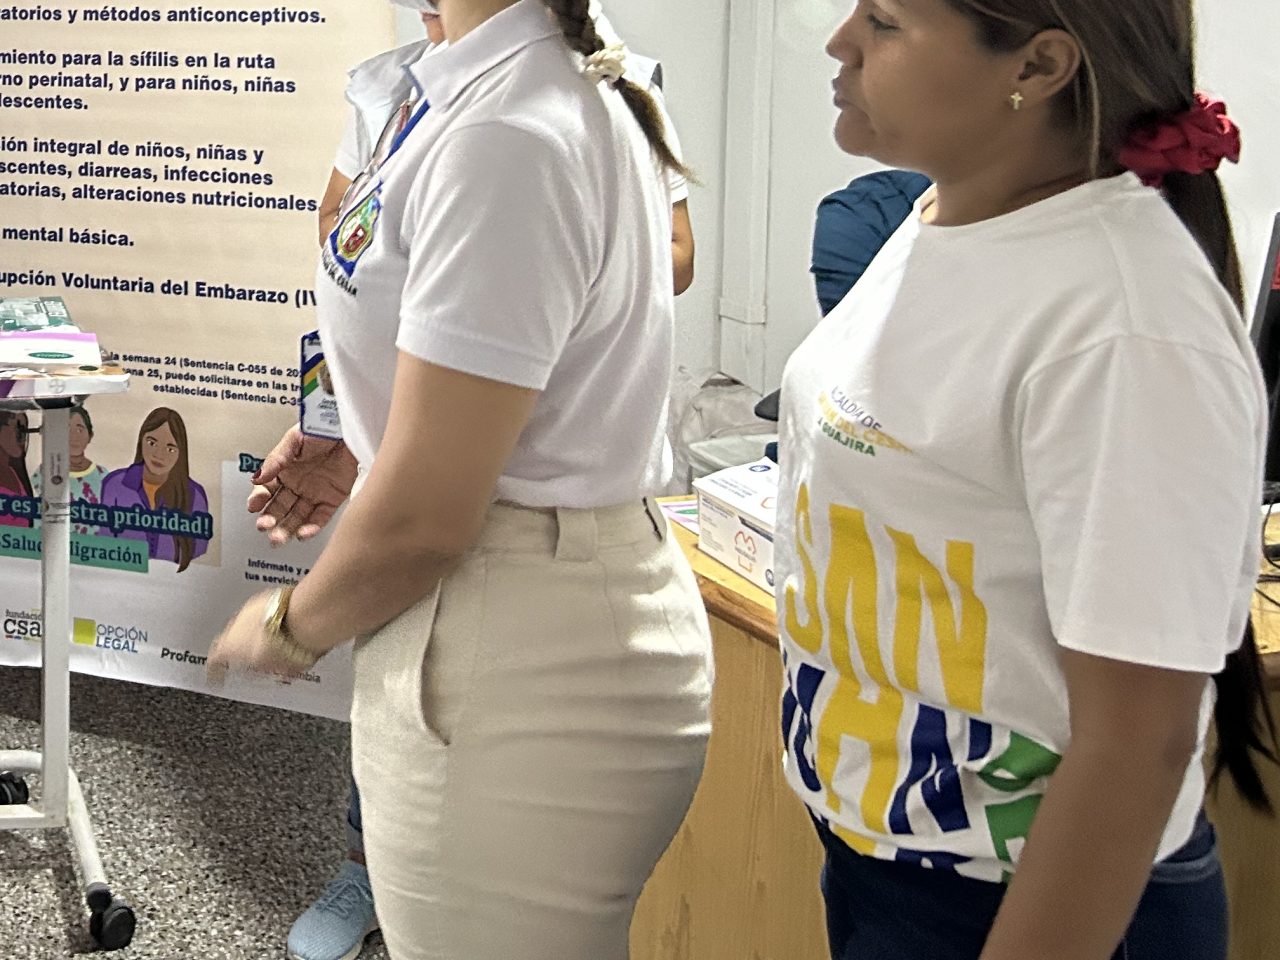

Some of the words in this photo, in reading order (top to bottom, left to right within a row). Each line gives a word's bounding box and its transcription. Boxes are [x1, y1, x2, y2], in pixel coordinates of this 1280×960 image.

[67, 8, 77, 24] y
[83, 5, 161, 23] métodos
[167, 6, 326, 26] anticonceptivos.
[62, 53, 102, 68] para
[108, 51, 124, 66] la
[130, 50, 179, 67] sífilis
[185, 55, 208, 68] en
[214, 53, 231, 68] la
[237, 54, 276, 69] ruta
[28, 71, 114, 91] perinatal,
[119, 77, 130, 92] y
[135, 77, 176, 92] para
[182, 75, 238, 94] niños,
[244, 76, 296, 93] niñas
[33, 137, 102, 157] integral
[107, 140, 129, 156] de
[135, 141, 191, 162] niños,
[196, 144, 247, 161] niñas
[253, 149, 264, 165] y
[78, 161, 158, 182] diarreas,
[164, 164, 274, 186] infecciones
[72, 184, 186, 204] alteraciones
[2, 226, 64, 242] mental
[69, 227, 135, 247] básica.
[61, 271, 155, 293] Voluntaria
[160, 279, 189, 296] del
[195, 281, 289, 304] Embarazo
[122, 354, 161, 364] semana
[164, 356, 176, 365] 24
[180, 357, 234, 371] (Sentencia
[237, 363, 267, 374] C-055
[270, 366, 282, 376] de
[147, 369, 162, 379] 25,
[165, 372, 196, 382] puede
[199, 374, 253, 387] solicitarse
[256, 380, 269, 389] en
[272, 381, 288, 391] las
[153, 384, 218, 398] establecidas
[221, 389, 277, 404] (Sentencia
[11, 499, 31, 514] es
[114, 507, 209, 536] prioridad!
[248, 559, 294, 573] Infórmate
[297, 567, 302, 575] y
[245, 572, 260, 581] tus
[263, 574, 299, 586] servicio
[96, 623, 148, 642] OPCIÓN
[95, 635, 138, 654] LEGAL
